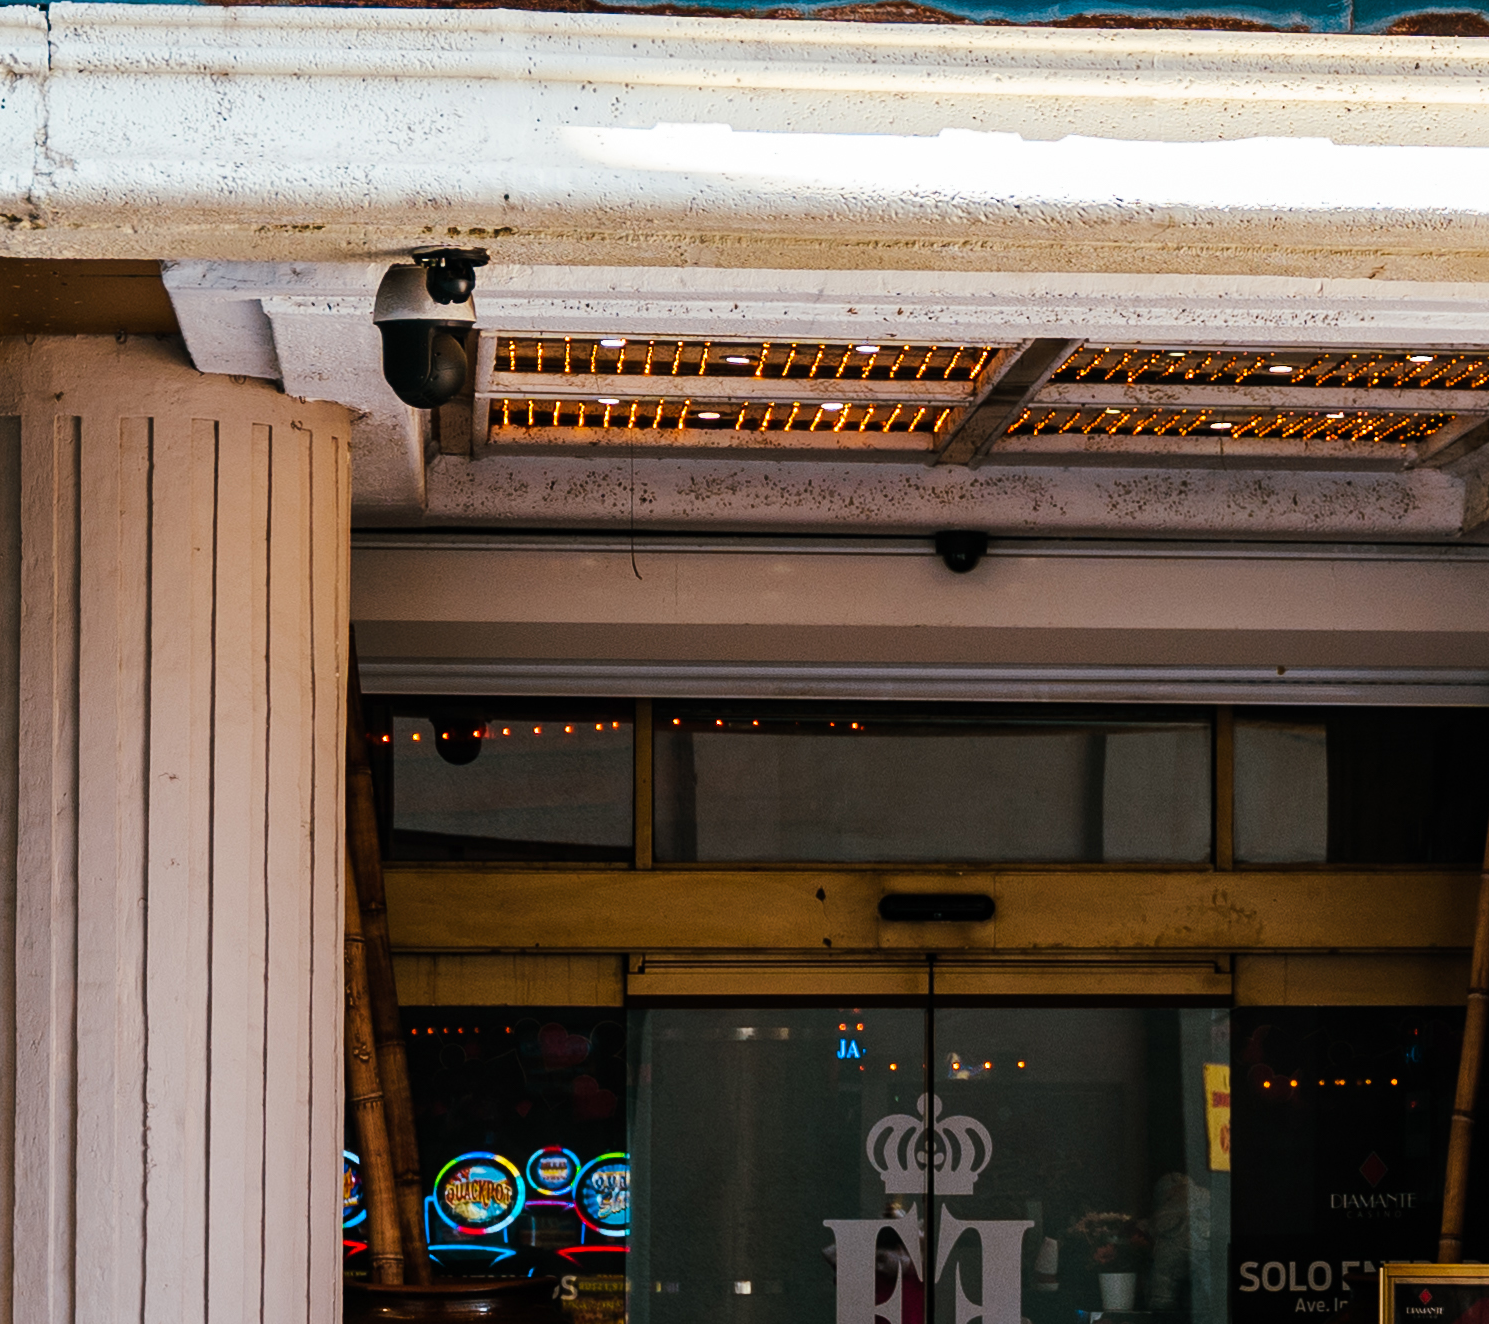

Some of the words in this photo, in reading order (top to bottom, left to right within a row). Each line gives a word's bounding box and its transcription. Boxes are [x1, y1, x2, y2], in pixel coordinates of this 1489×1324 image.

[1330, 1193, 1417, 1209] DIAMANTE
[1238, 1260, 1333, 1293] SOLO
[1294, 1297, 1330, 1313] Ave.
